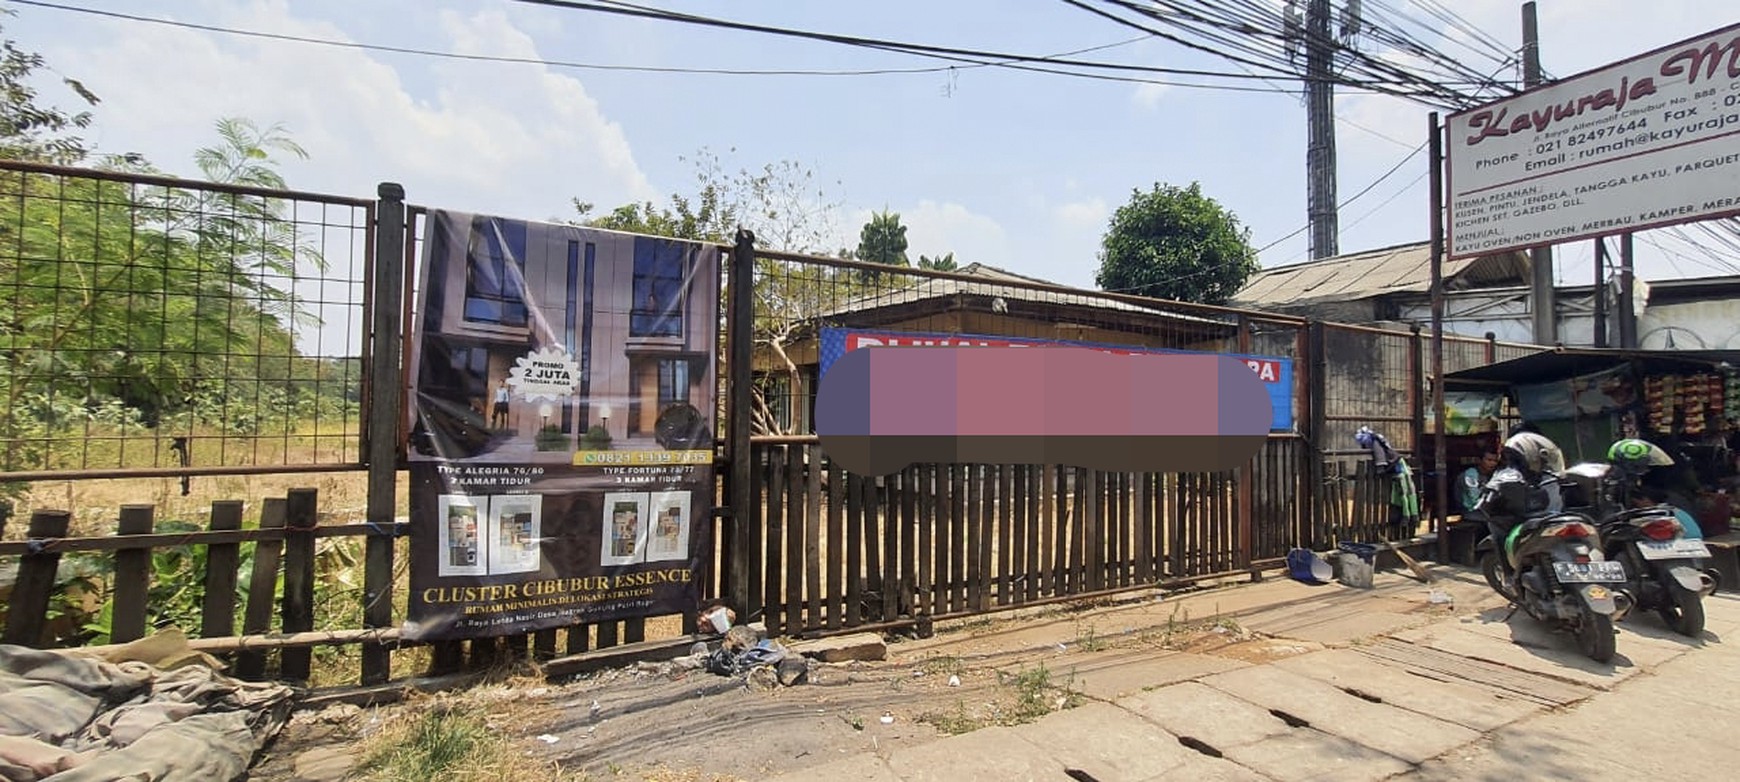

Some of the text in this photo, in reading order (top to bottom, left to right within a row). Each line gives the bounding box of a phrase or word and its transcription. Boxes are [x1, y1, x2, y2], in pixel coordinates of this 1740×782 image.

[1467, 76, 1657, 146] Kayuraja
[1572, 113, 1618, 132] Alternatif
[1621, 102, 1666, 118] Cibubur
[1694, 88, 1716, 99] 888
[1475, 152, 1519, 170] Phone
[1536, 139, 1562, 154] 021
[1567, 117, 1648, 146] 82497644
[1664, 107, 1698, 122] Fax
[1525, 153, 1566, 171] Email
[1575, 178, 1628, 194] TANGGA
[1455, 196, 1487, 210] TERIMA
[1489, 186, 1538, 201] PESANAN
[1456, 216, 1490, 229] KICHEN
[1456, 243, 1480, 252] KAYU
[533, 361, 564, 369] PROMO
[525, 368, 570, 380] 2 JUTA
[437, 465, 461, 474] TYPE
[465, 467, 510, 475] ALEGRIA
[603, 467, 625, 475] TYPE
[460, 477, 497, 486] KAMAR
[500, 477, 532, 486] TIDUR
[624, 475, 656, 484] KAMAR
[658, 475, 682, 483] TIDUR
[423, 568, 692, 604] CLUSTER CIBUBUR ESSENCE
[464, 605, 503, 615] RUMAH
[505, 597, 558, 610] MINIMALIS
